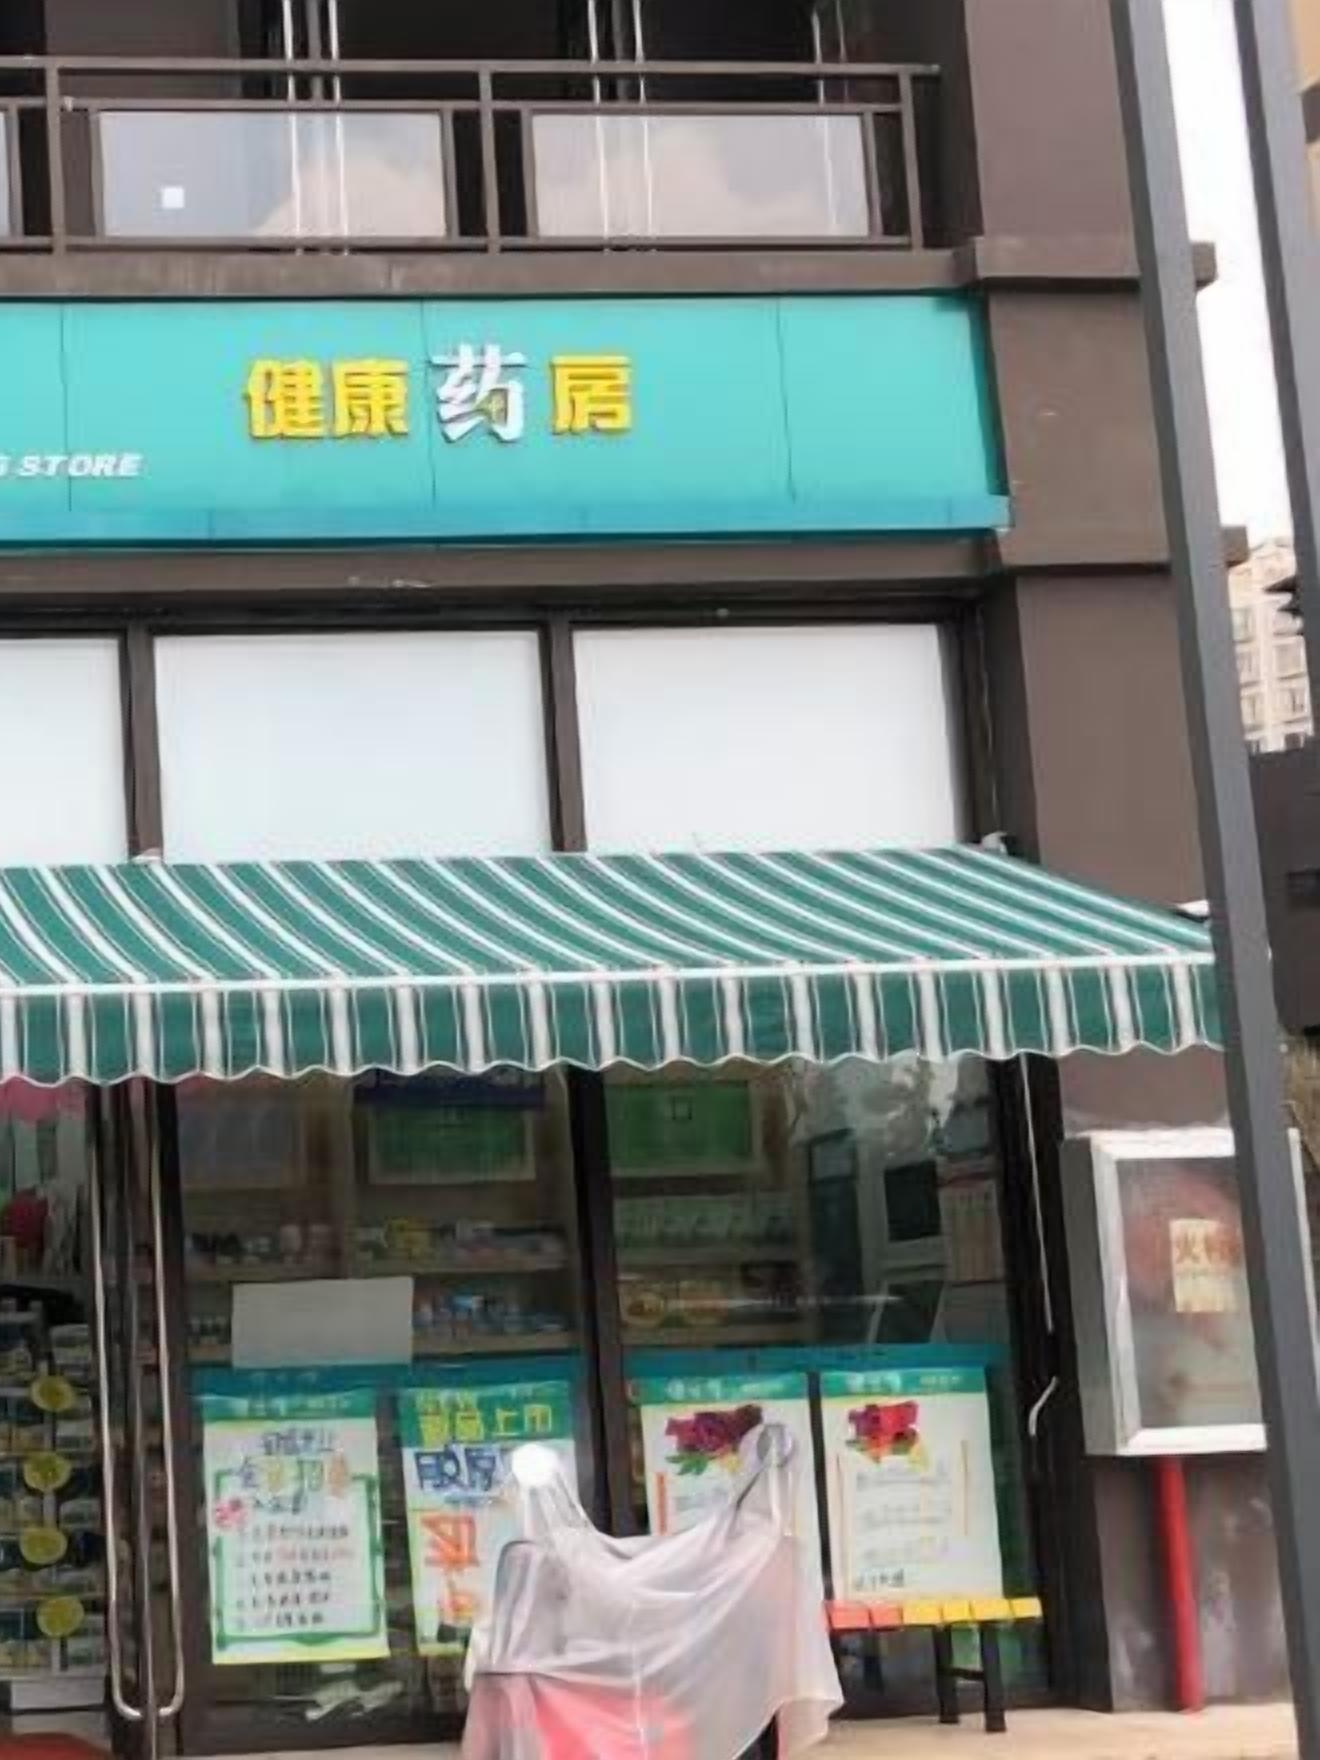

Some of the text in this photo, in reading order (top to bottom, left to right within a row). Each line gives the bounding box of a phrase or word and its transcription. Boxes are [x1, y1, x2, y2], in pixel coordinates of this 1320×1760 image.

[246, 344, 633, 444] 健康药房
[17, 453, 143, 479] STORE
